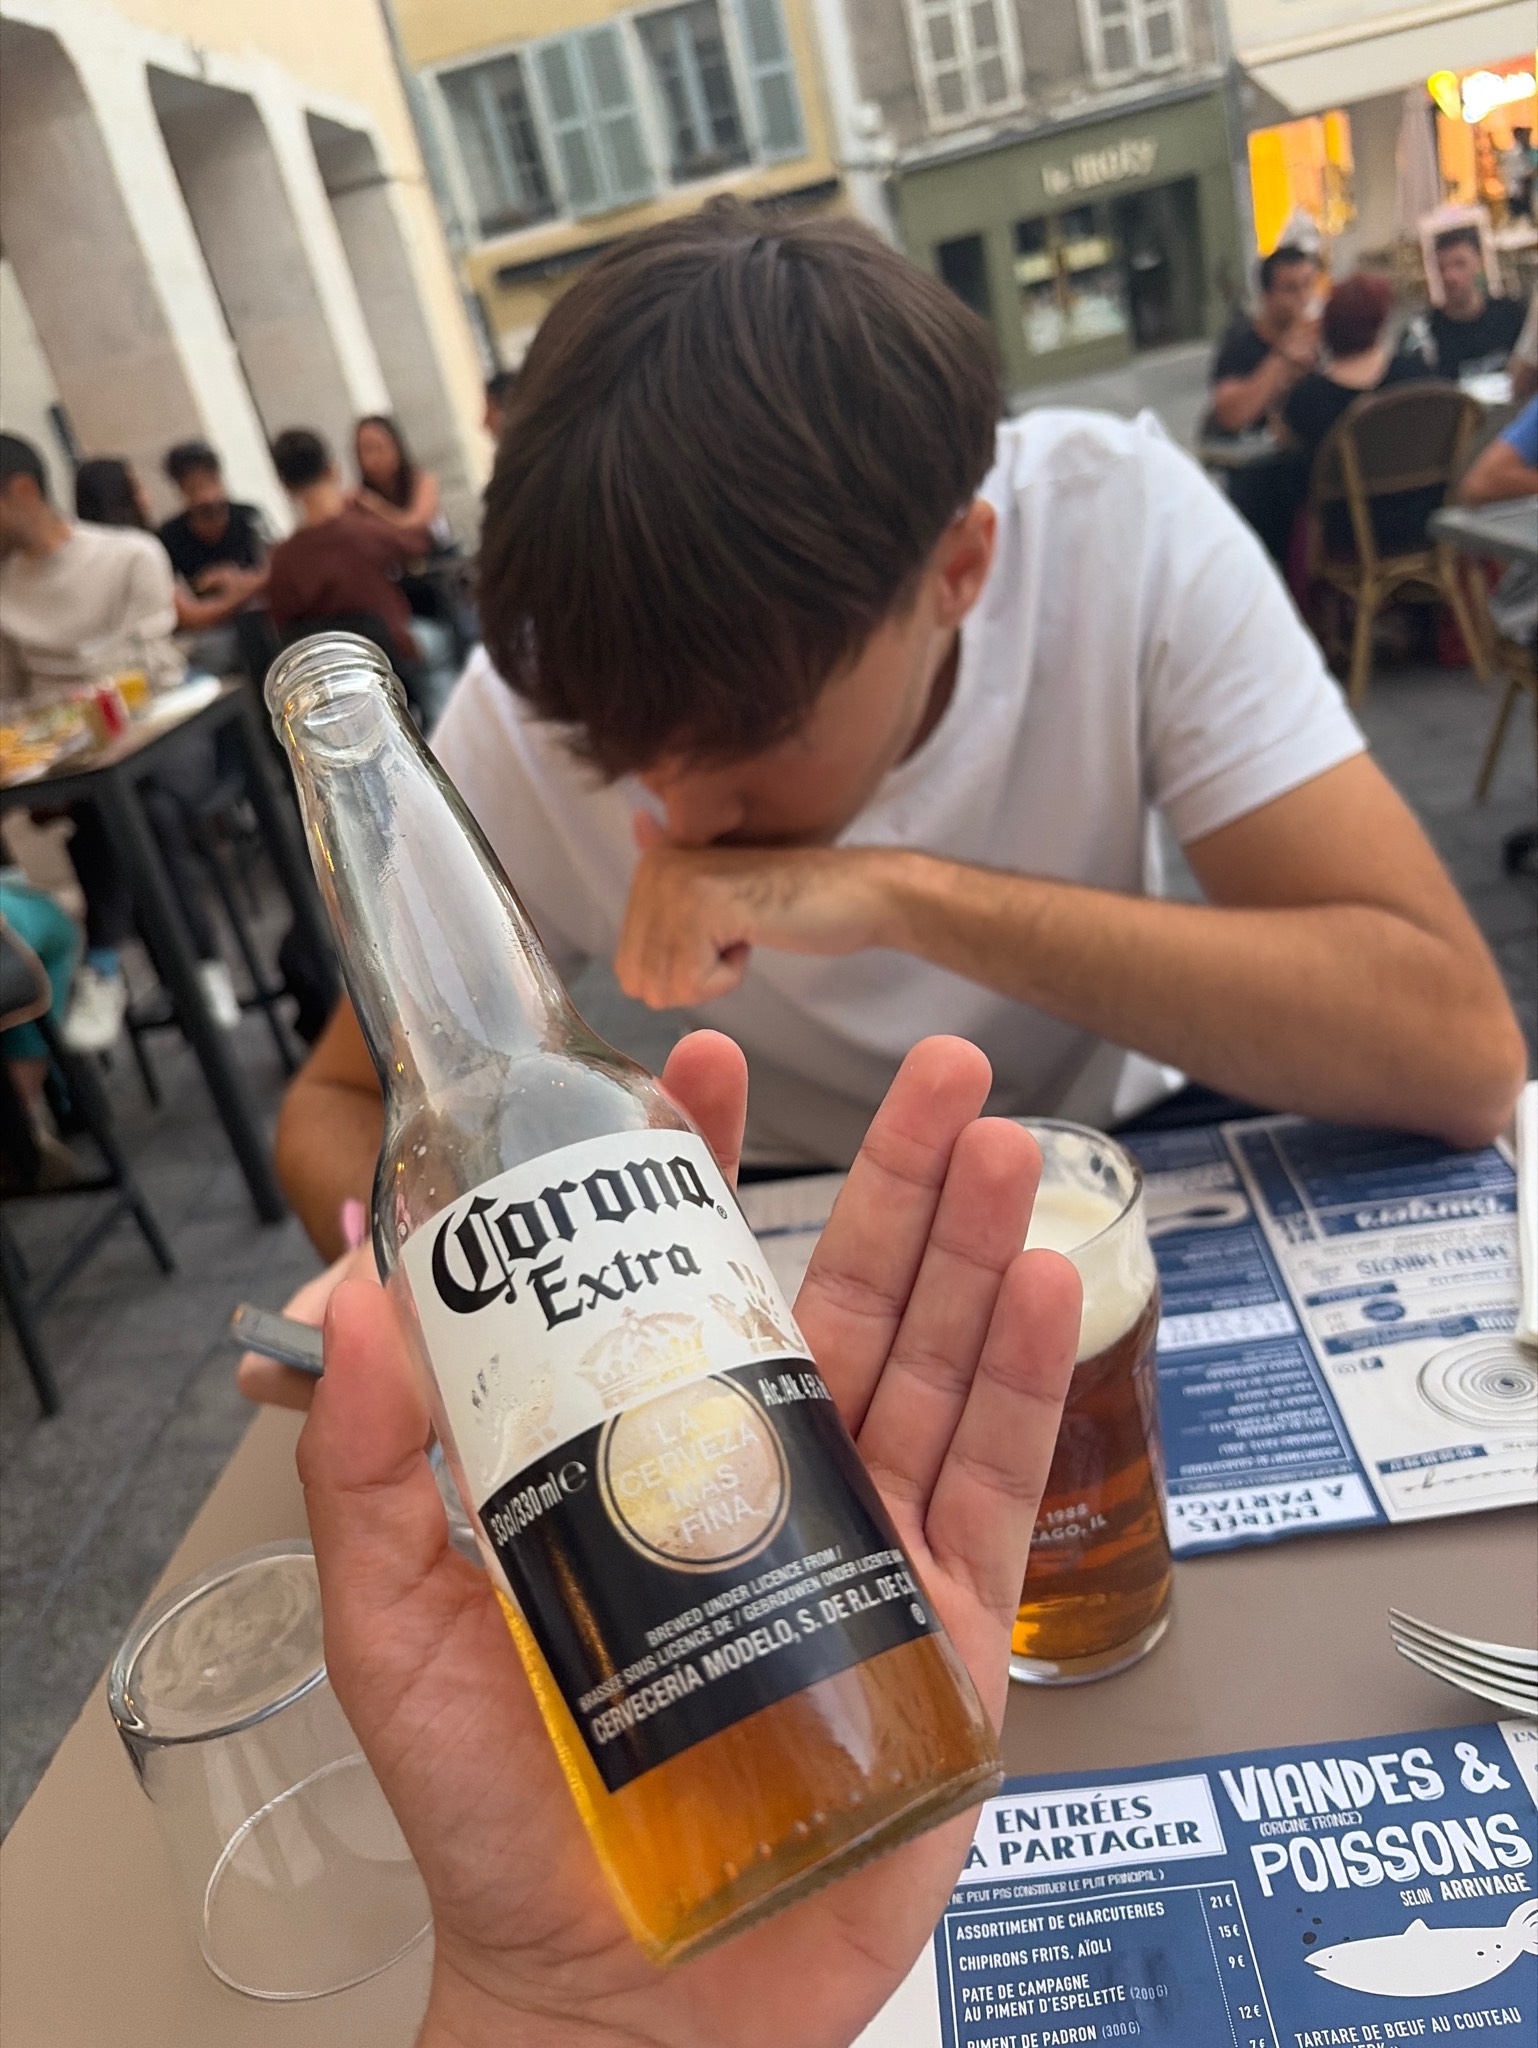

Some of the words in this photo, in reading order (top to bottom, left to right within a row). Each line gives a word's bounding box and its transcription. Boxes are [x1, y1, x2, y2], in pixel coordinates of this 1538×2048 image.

[432, 1155, 714, 1314] Corona
[527, 1242, 701, 1331] Extra
[654, 1409, 699, 1445] LA
[618, 1421, 759, 1498] CERVEZA
[679, 1494, 755, 1545] FINA
[1175, 1488, 1312, 1516] PARTAGE
[645, 1607, 703, 1648] BREWED
[702, 1584, 751, 1618] UNDER
[749, 1560, 804, 1596] LICENCE
[802, 1547, 837, 1571] FROM
[622, 1654, 658, 1685] SOUS
[656, 1625, 714, 1666] LICENCE
[712, 1614, 735, 1637] DE
[741, 1575, 821, 1621] GEBROUWEN
[820, 1561, 858, 1587] ONDER
[591, 1663, 705, 1745] CERVECERÍA
[701, 1617, 801, 1680] MODELO,
[797, 1608, 822, 1633] S.
[819, 1593, 850, 1623] DE
[845, 1584, 882, 1613] R.L.
[875, 1575, 900, 1601] DE
[1219, 1747, 1446, 1822] VIANDES
[1454, 1741, 1511, 1794] &
[995, 1793, 1152, 1835] ENTRÉES
[1259, 1815, 1311, 1837] (ORIGINE
[1312, 1811, 1363, 1830] FRANCE)
[1000, 1820, 1202, 1866] PARTAGER
[1250, 1813, 1533, 1897] POISSONS
[967, 1888, 990, 1904] PEUT
[993, 1887, 1012, 1901] PAS
[1069, 1879, 1081, 1892] LE
[1400, 1887, 1434, 1908] SELON
[1439, 1871, 1532, 1902] ARRIVAGE
[956, 1916, 1044, 1941] ASSORTIMENT
[1049, 1914, 1066, 1931] DE
[1068, 1902, 1165, 1927] CHARCUTERIES
[958, 1950, 1028, 1972] CHIPIRONS
[1077, 1937, 1112, 1958] AÏOLI
[962, 1986, 994, 2003] PATE
[998, 1983, 1014, 1999] DE
[1018, 1974, 1090, 1997] CAMPAGNE
[964, 2006, 981, 2022] AU
[985, 1999, 1034, 2020] PIMENT
[1039, 1985, 1126, 2014] D'ESPELETTE
[966, 2034, 1018, 2048] PIMENT
[1021, 2032, 1038, 2048] DE
[1042, 2025, 1097, 2046] PADRON
[1294, 2026, 1360, 2048] TARTARE
[1361, 2024, 1382, 2041] DE
[1383, 2018, 1426, 2039] BŒUF
[1431, 2015, 1451, 2033] AU
[1453, 2006, 1522, 2030] COUTEAU
